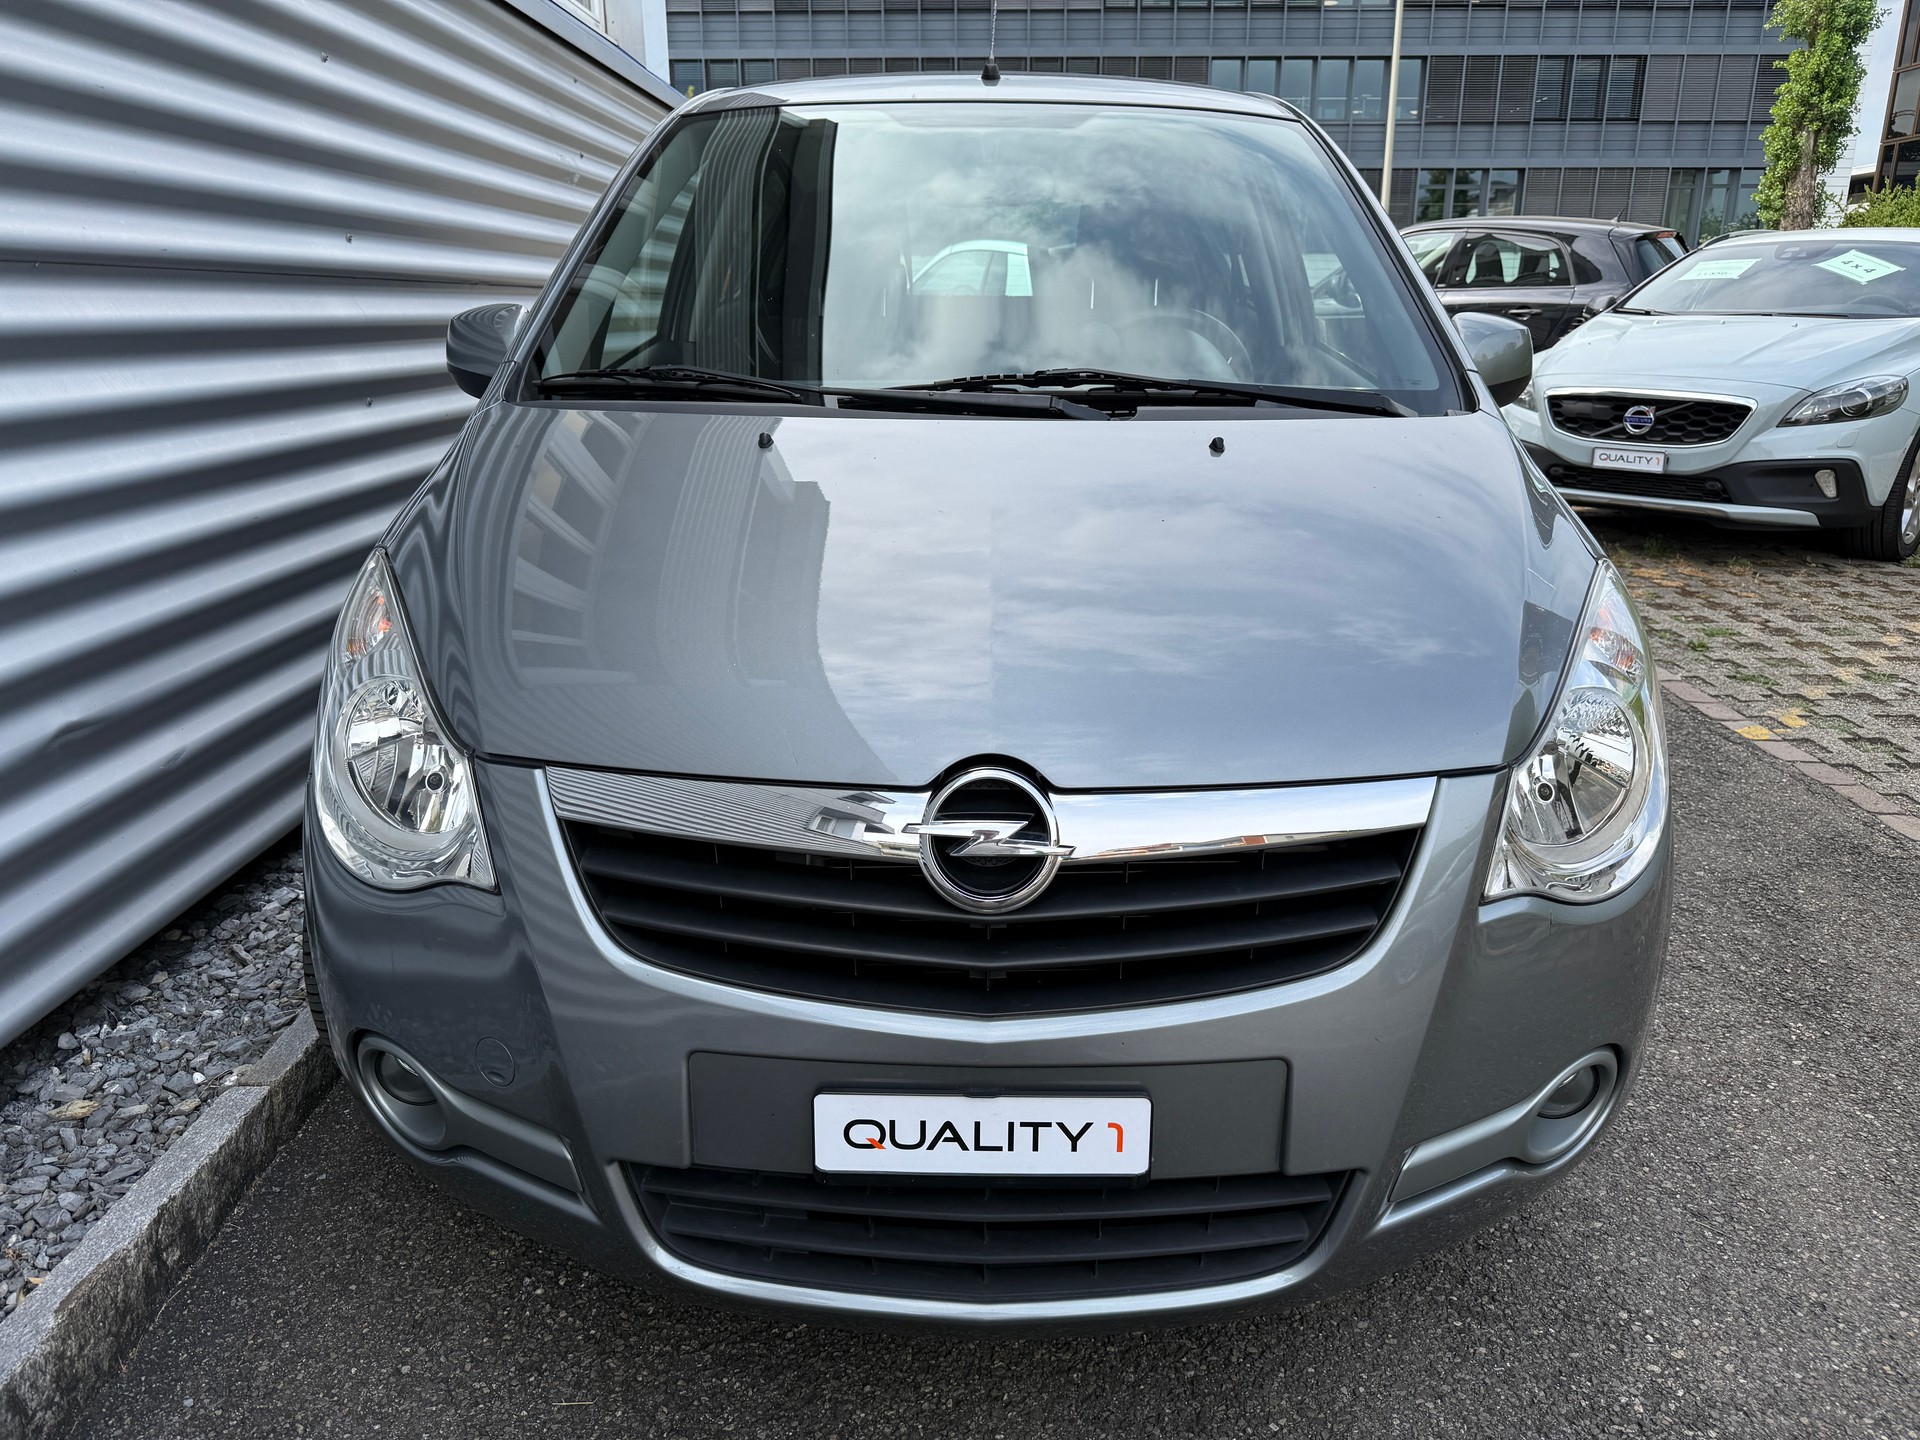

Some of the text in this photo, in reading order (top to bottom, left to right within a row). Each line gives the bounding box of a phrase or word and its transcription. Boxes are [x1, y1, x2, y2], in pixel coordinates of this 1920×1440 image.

[1598, 453, 1653, 465] QUALITY
[843, 1119, 1124, 1153] QUALITY 1
